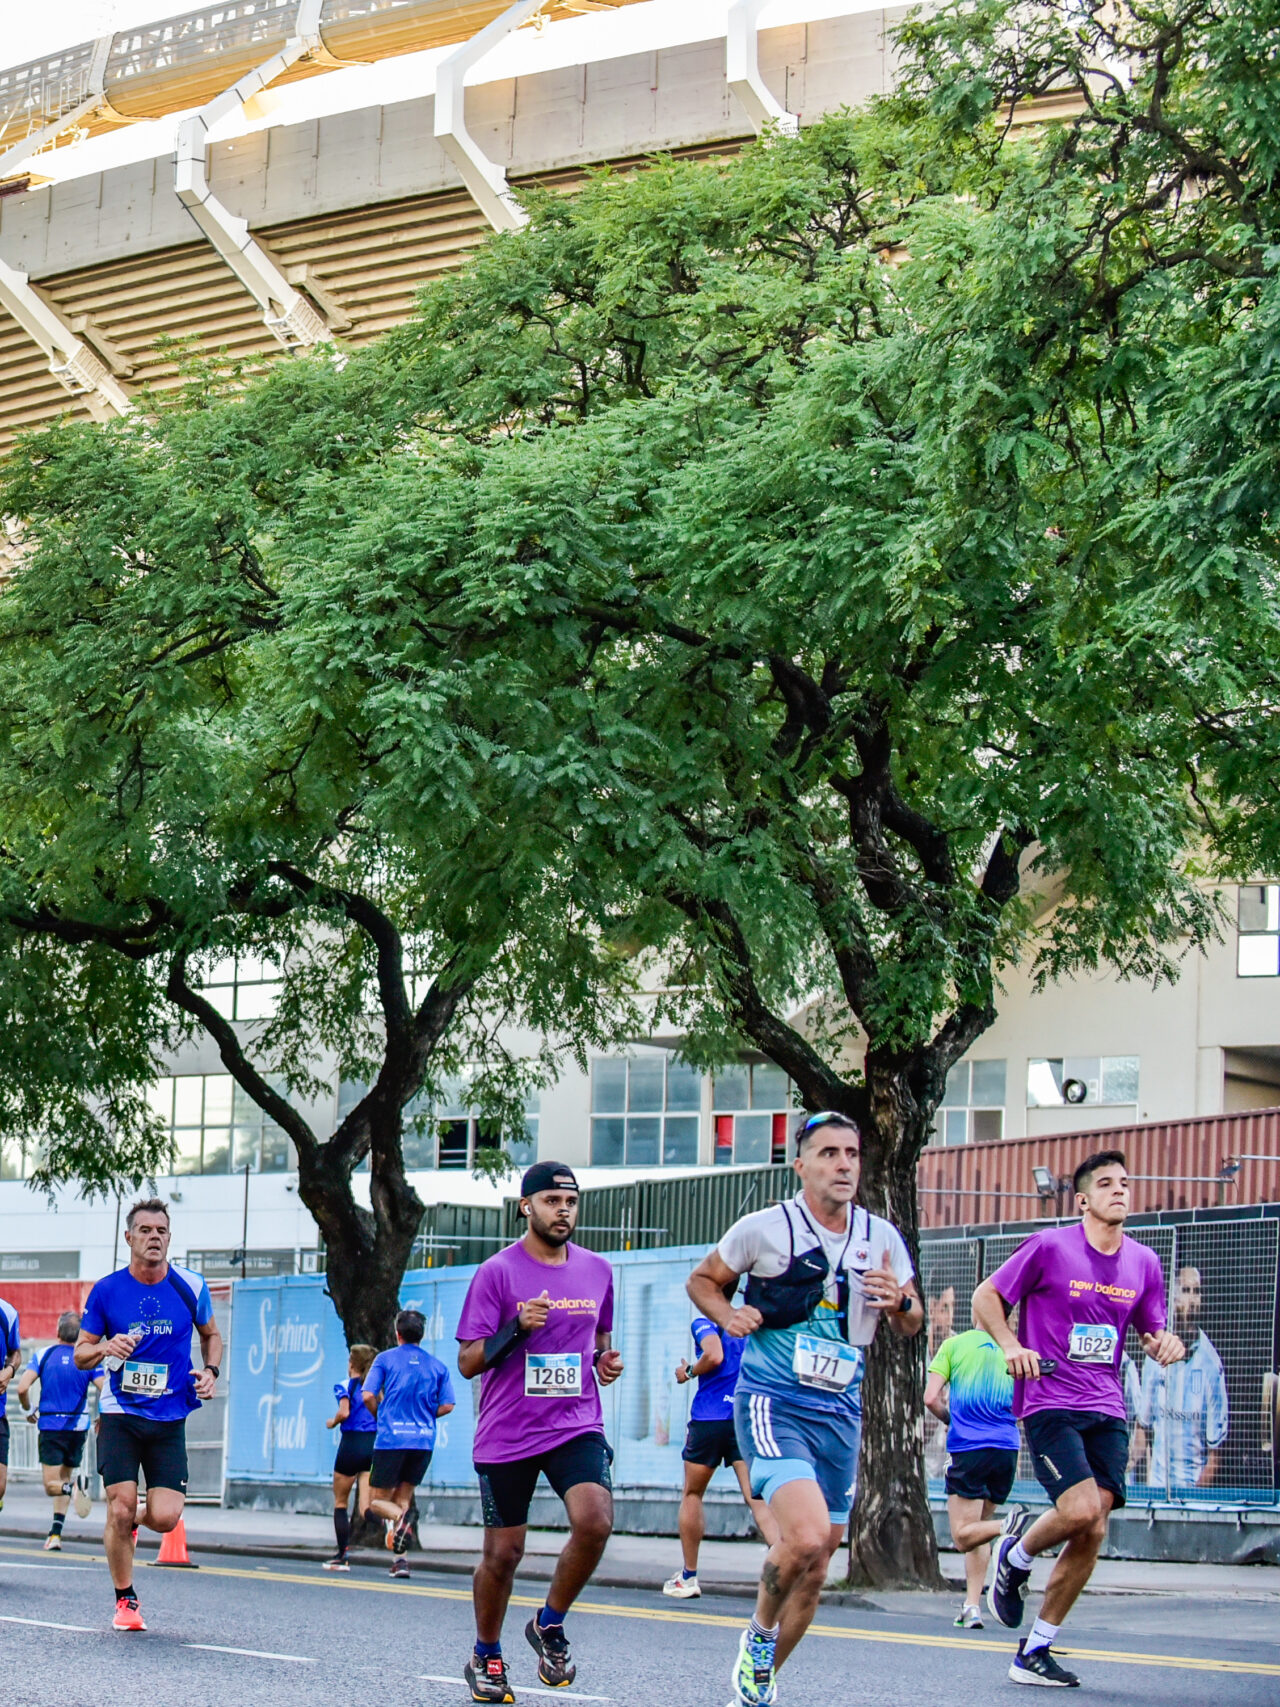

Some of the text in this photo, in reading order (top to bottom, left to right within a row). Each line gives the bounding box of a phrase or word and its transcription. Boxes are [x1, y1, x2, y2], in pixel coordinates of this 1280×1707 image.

[1069, 1279, 1137, 1299] new balance
[153, 1325, 173, 1336] RUN
[1077, 1336, 1112, 1353] 1623
[811, 1354, 840, 1377] 171
[131, 1372, 158, 1386] 816
[532, 1367, 576, 1385] 1268
[258, 1394, 307, 1458] Tuch
